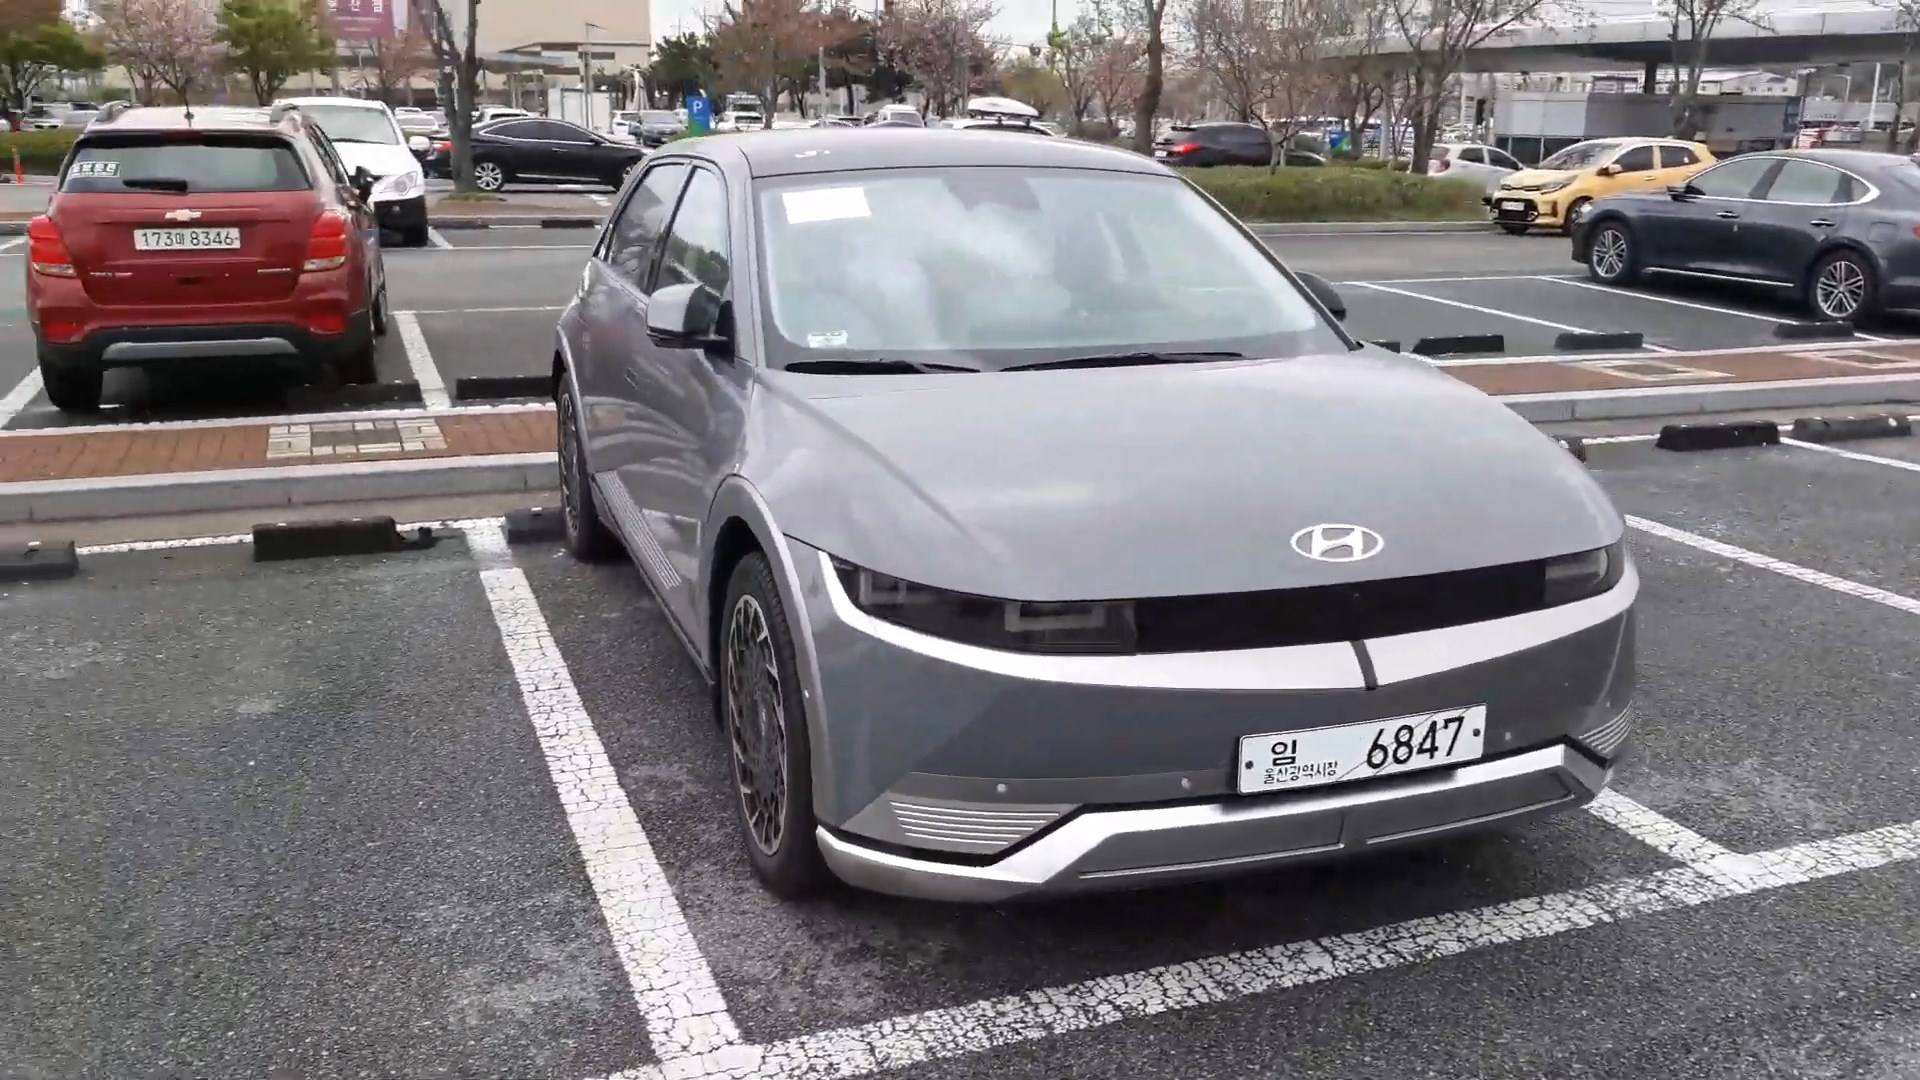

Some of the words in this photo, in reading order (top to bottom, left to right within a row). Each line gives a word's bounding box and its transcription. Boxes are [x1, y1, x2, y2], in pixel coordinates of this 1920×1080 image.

[693, 100, 703, 113] P
[190, 230, 234, 246] 8346
[1271, 740, 1297, 767] 임
[1367, 716, 1465, 769] 6847
[1263, 760, 1338, 784] 울산광역시장
